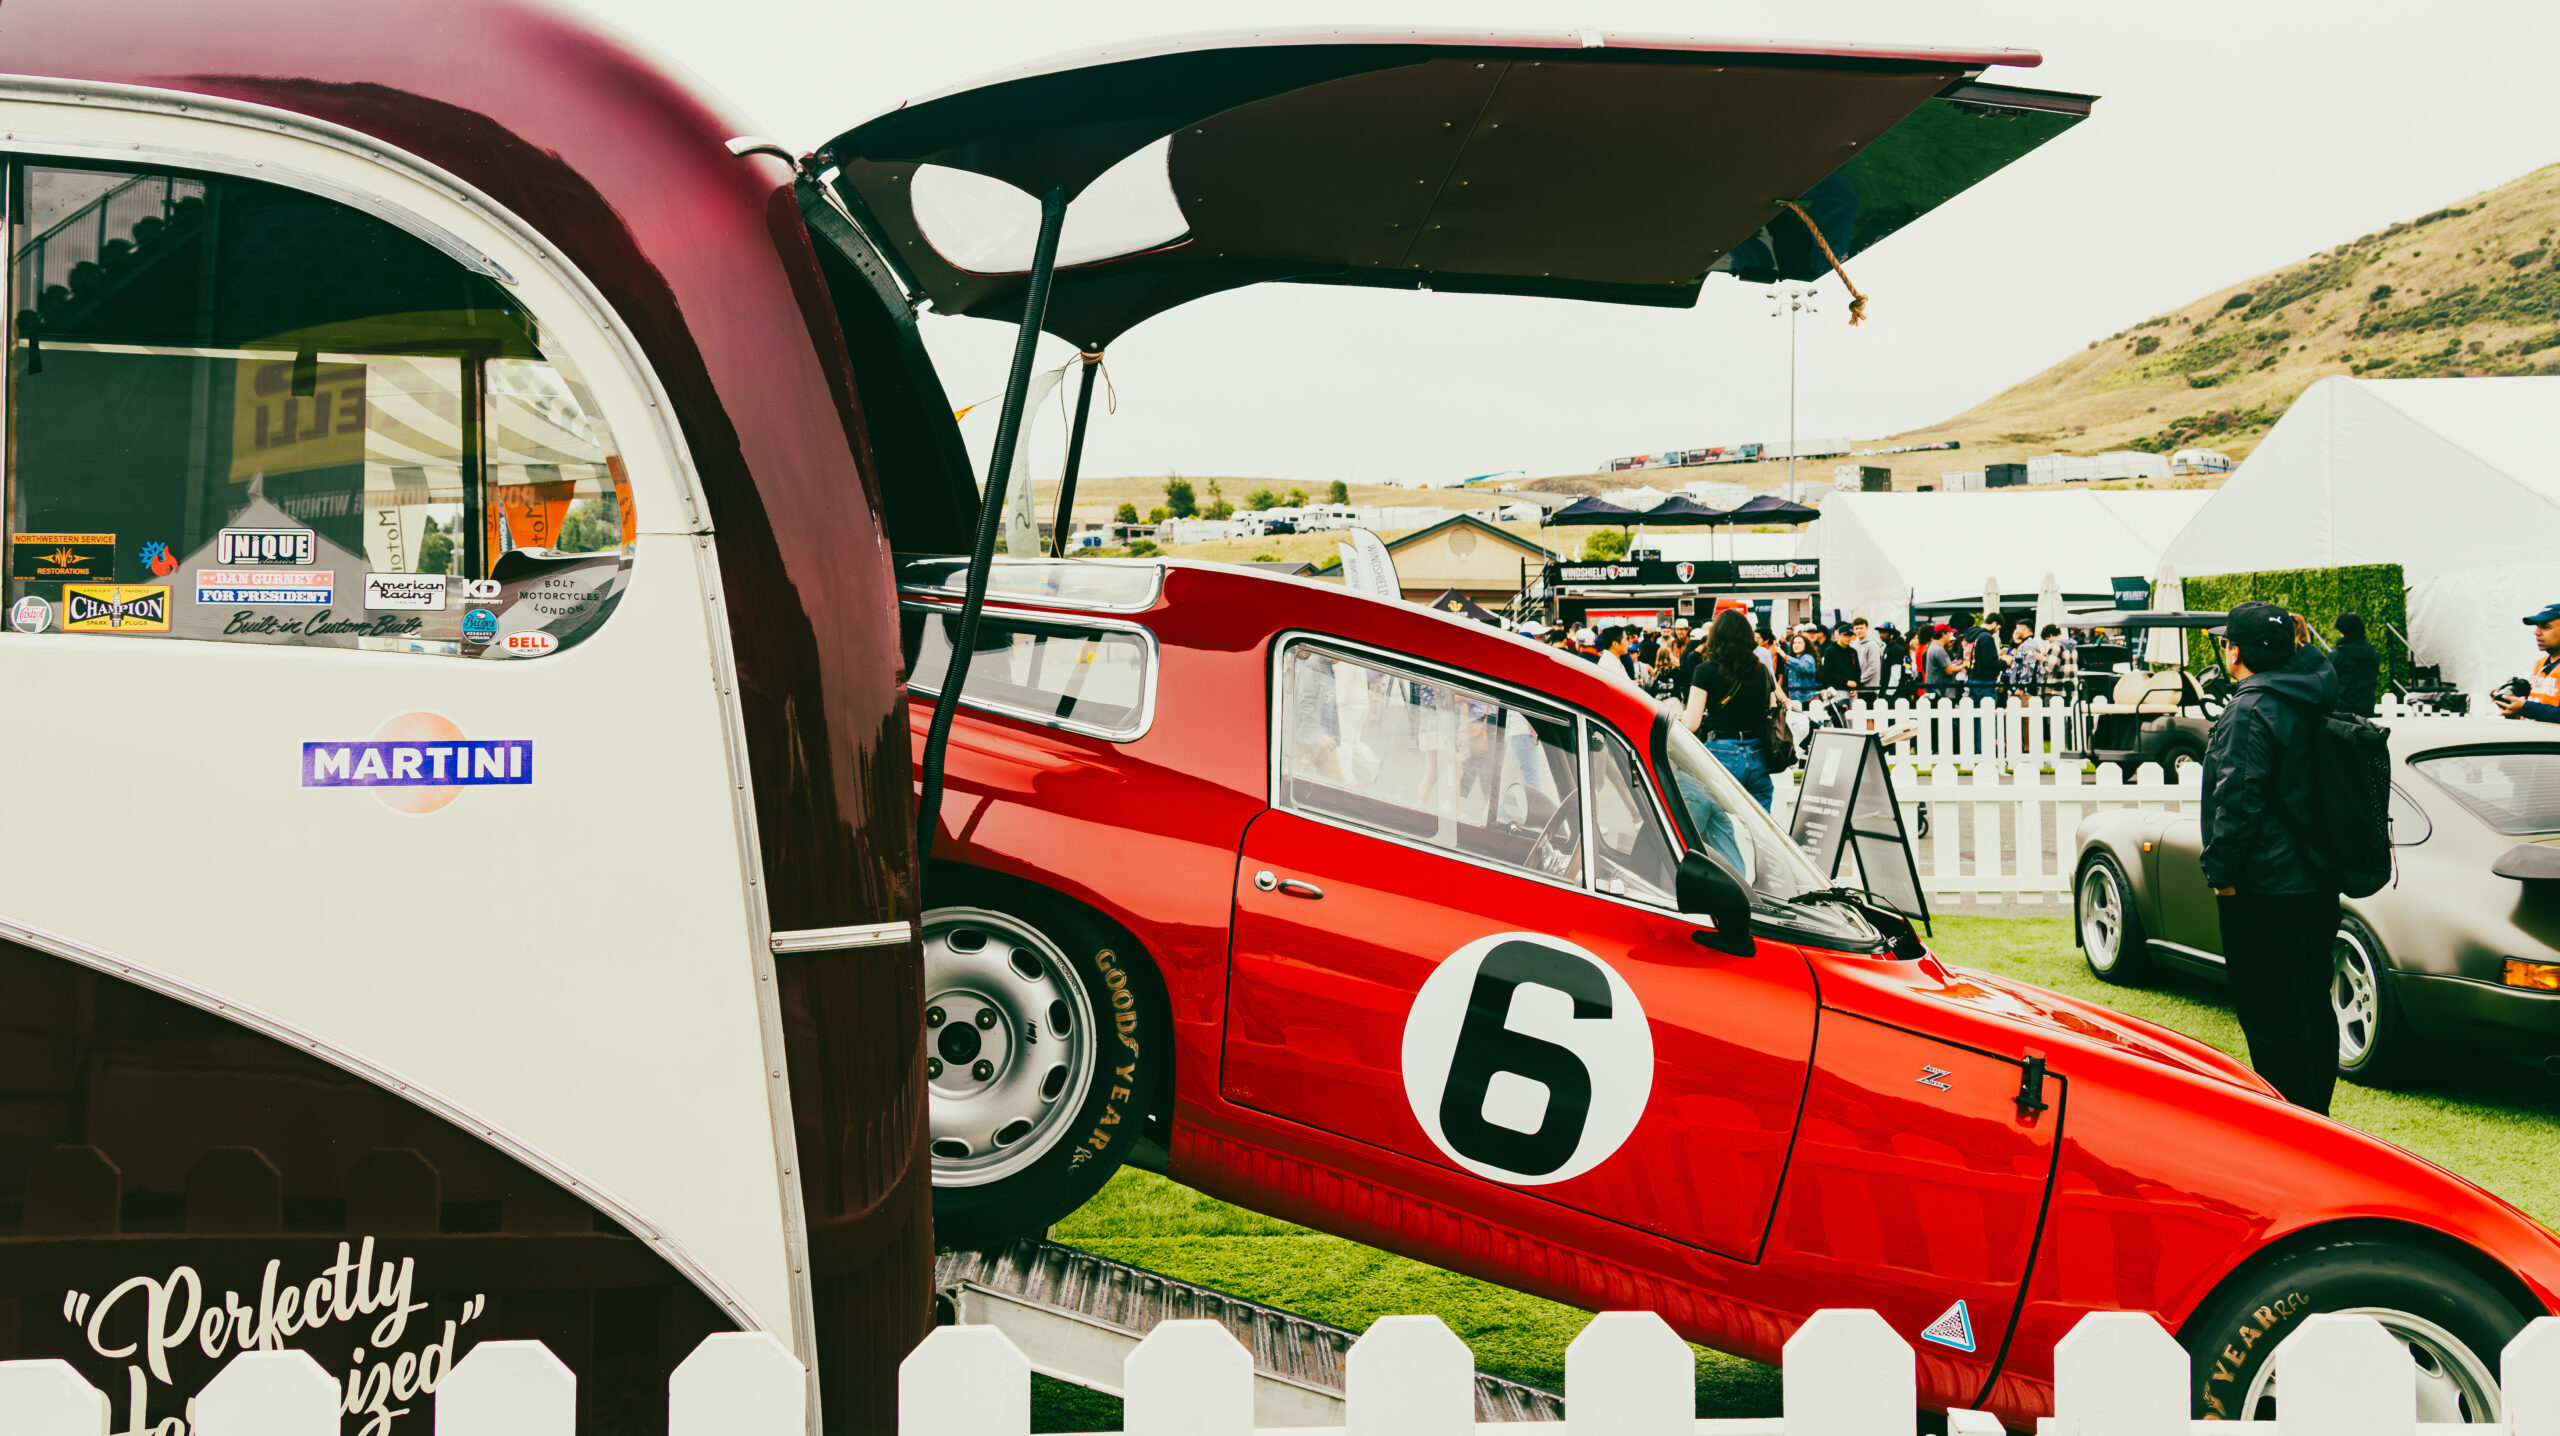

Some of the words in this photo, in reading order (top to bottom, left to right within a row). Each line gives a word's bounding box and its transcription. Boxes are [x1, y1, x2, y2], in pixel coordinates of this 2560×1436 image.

[15, 535, 79, 543] NORTHWESTERN
[81, 535, 113, 543] SERVICE
[37, 567, 90, 575] RESTORATIONS
[1560, 567, 1607, 578] WINDSHIELD
[1619, 566, 1638, 577] SKIN
[1738, 565, 1785, 576] WINDSHIELD
[1797, 564, 1818, 575] SKIN
[215, 573, 249, 584] DAN
[251, 573, 316, 585] GURNEY
[369, 580, 444, 590] American
[545, 579, 575, 588] BOLT
[462, 579, 502, 598] KD
[202, 590, 235, 602] FOR
[236, 590, 328, 603] PRESIDENT
[380, 589, 432, 604] Racing
[519, 591, 599, 600] MOTORCYCLES
[71, 596, 164, 620] CHAMPION
[534, 603, 584, 615] LONDON
[223, 610, 302, 635] Built-in
[509, 637, 549, 648] BELL
[313, 747, 522, 780] MARTINI
[1439, 940, 1613, 1176] 6
